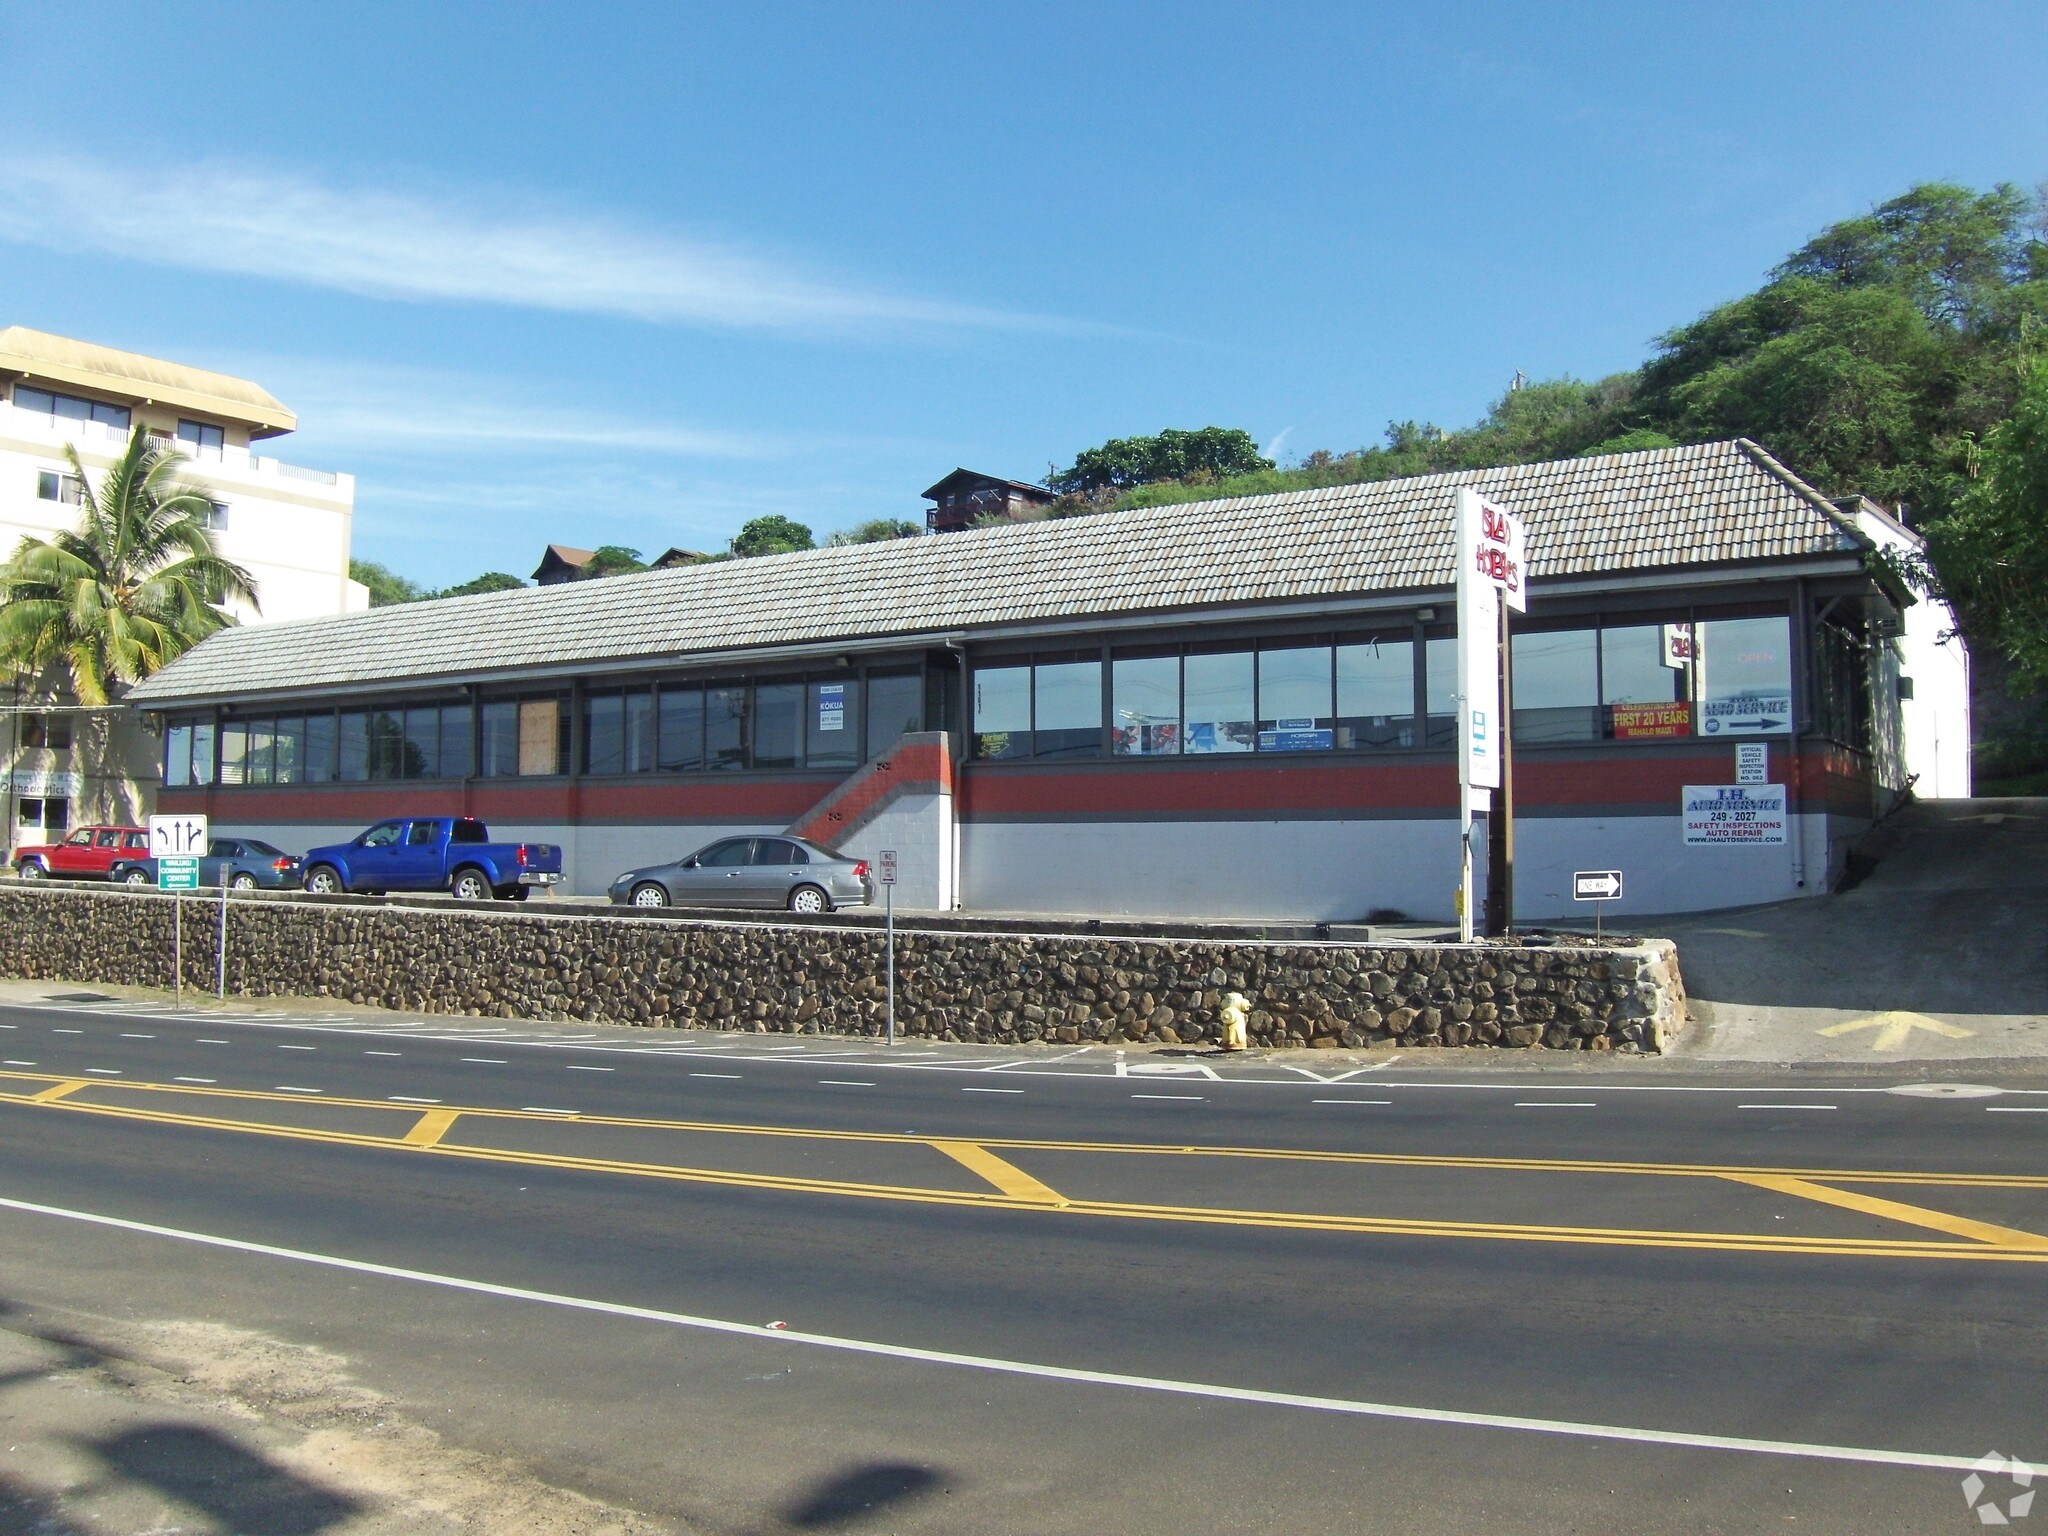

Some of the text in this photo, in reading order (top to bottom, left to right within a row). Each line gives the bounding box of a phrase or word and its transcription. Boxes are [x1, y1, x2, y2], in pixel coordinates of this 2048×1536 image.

[1704, 702, 1735, 716] AUTO
[1735, 700, 1788, 715] SERVICE
[1614, 710, 1689, 727] FIRST 20 YEARS
[1627, 728, 1655, 736] MAHALO
[1716, 788, 1748, 800] I.H.
[1687, 799, 1782, 811] AUTO SERVICE
[1711, 812, 1727, 821] 249
[1735, 812, 1757, 821] 2027
[1580, 880, 1607, 891] ONE WAY
